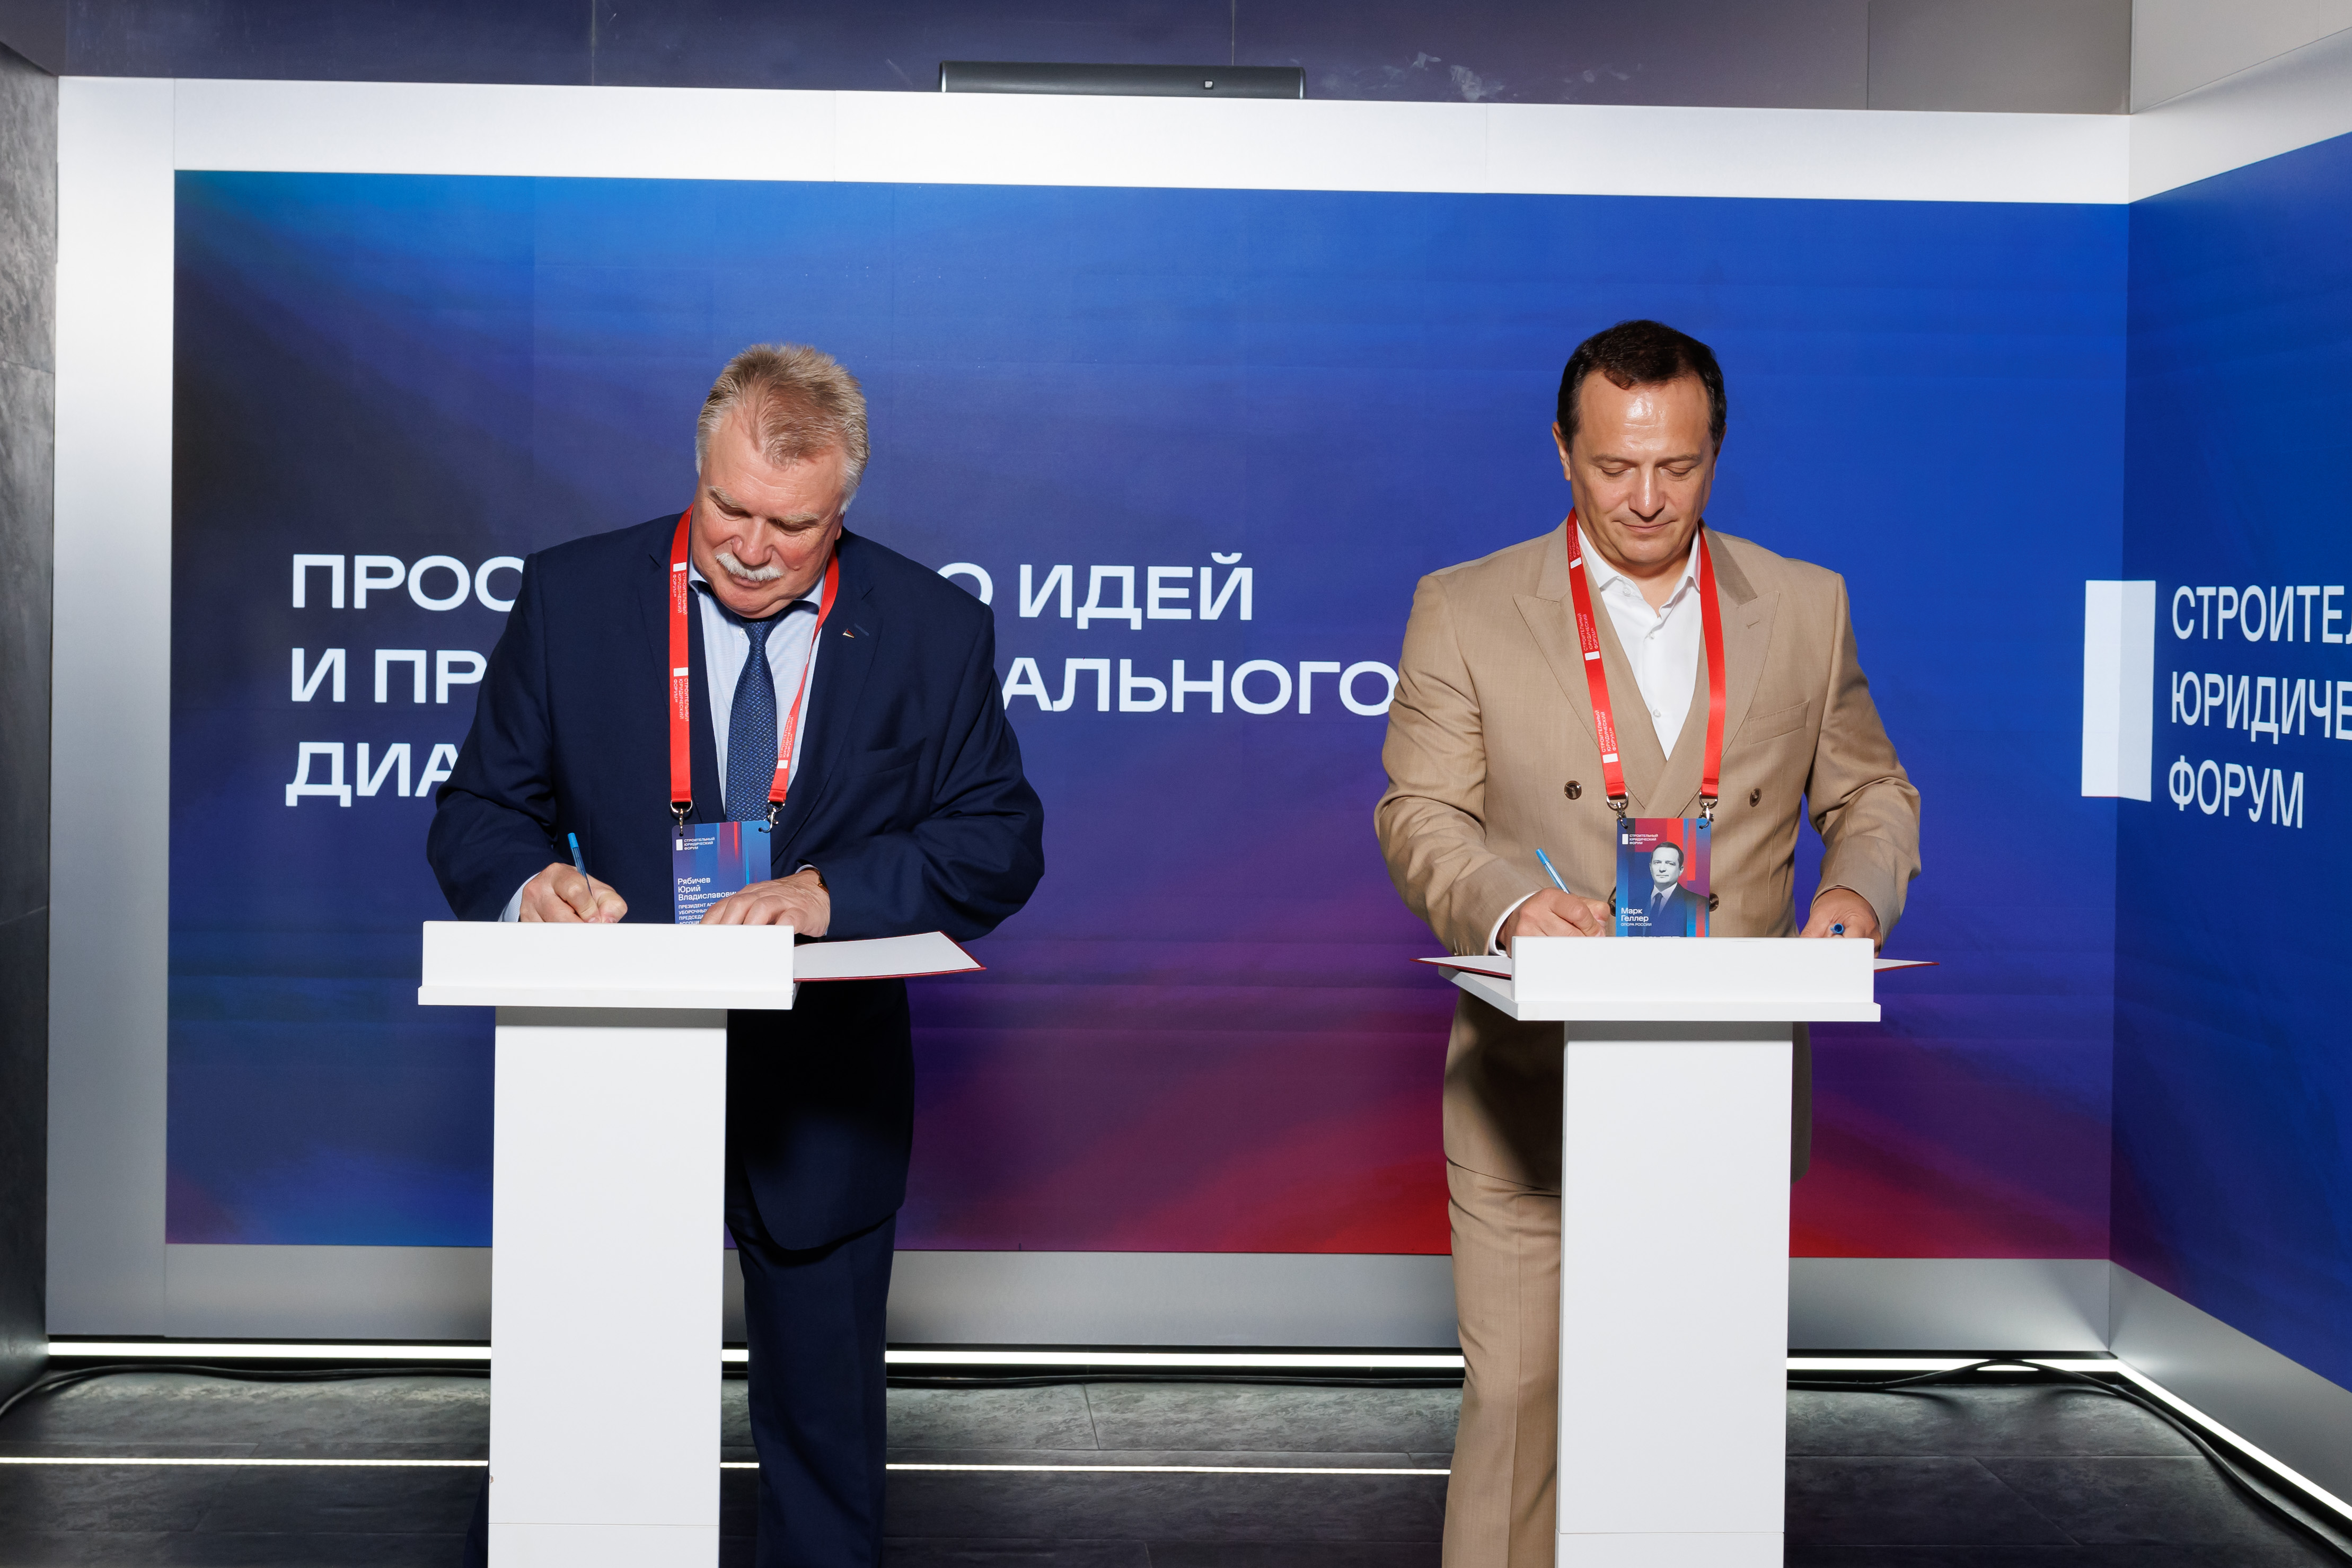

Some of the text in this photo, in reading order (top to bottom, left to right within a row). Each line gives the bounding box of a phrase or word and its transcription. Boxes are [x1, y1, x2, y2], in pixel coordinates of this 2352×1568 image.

[293, 554, 525, 612] ПРОС
[1019, 552, 1253, 630] ИДЕЙ
[1577, 613, 1588, 651] СТРОИТЕЛЬНЫЙ
[1583, 614, 1593, 650] ЮРИДИЧЕСКИЙ
[291, 648, 1399, 716] И ПР АЛЬНОГО
[1594, 710, 1606, 753] СТРОИТЕЛЬНЫЙ
[1600, 711, 1611, 752] ЮРИДИЧЕСКИЙ
[285, 742, 459, 807] ДИА
[2169, 755, 2304, 829] ФОРУМ
[677, 877, 711, 885] Рябичев
[678, 884, 701, 894] Юрий
